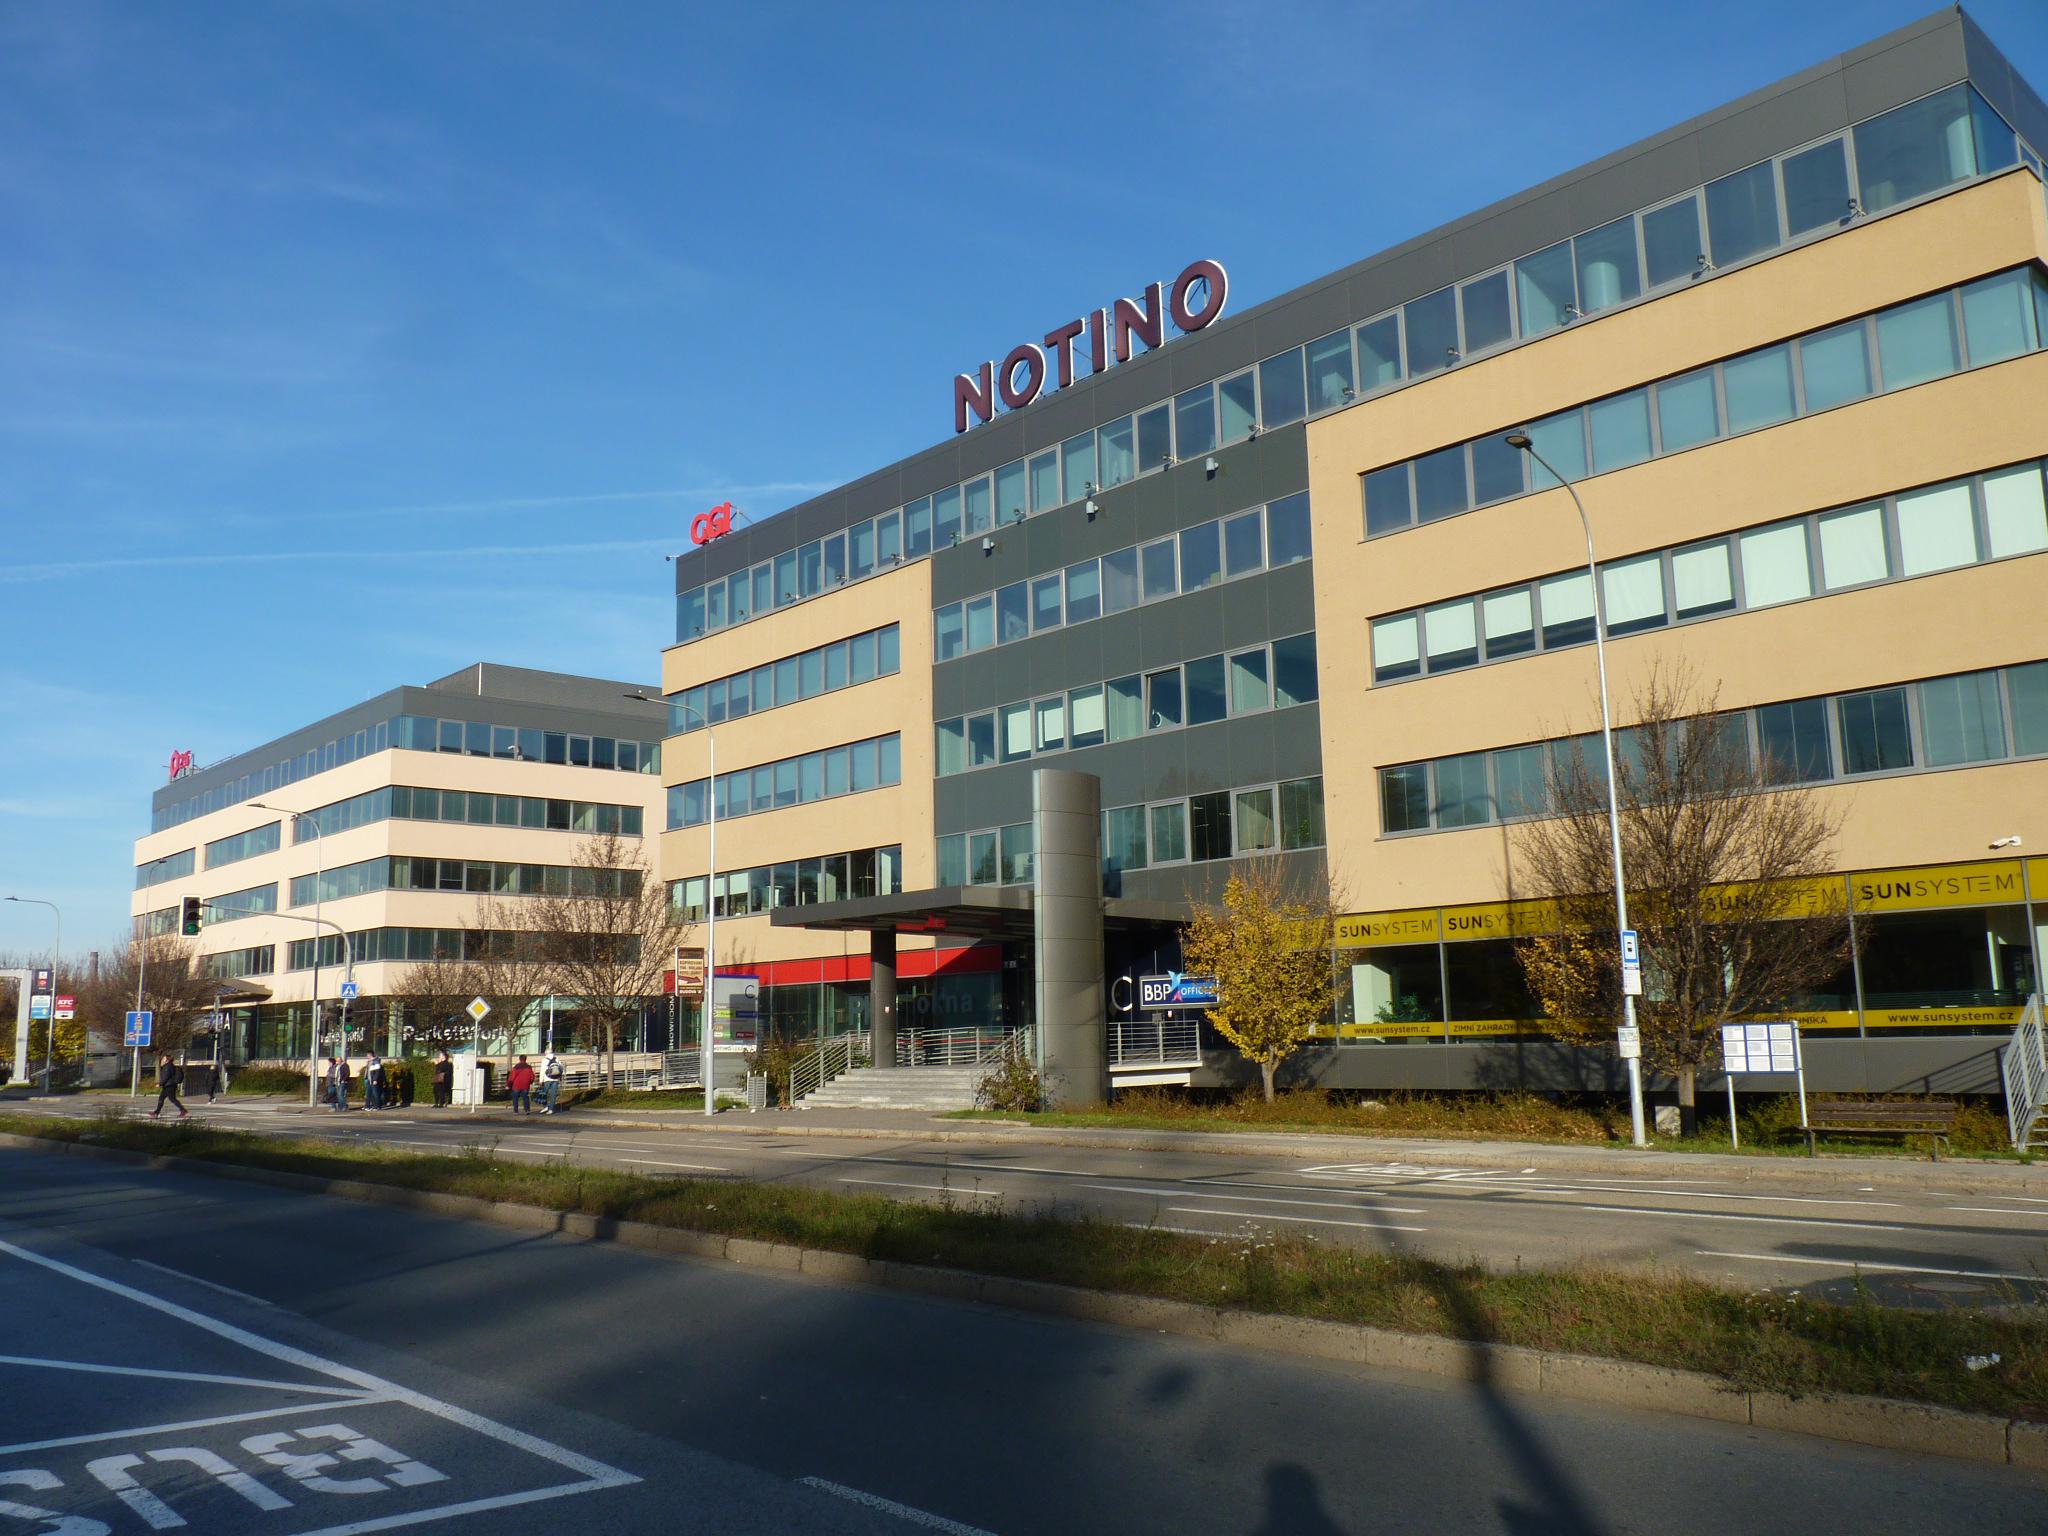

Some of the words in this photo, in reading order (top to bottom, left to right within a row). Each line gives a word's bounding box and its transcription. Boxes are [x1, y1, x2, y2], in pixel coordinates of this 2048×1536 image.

[954, 259, 1229, 433] NOTINO
[1862, 873, 2015, 900] SUNSYSTEM
[1704, 887, 1837, 912] SUNSTEM
[1340, 918, 1433, 938] SUNSYSTEM
[1448, 910, 1552, 930] SUNSYSTEM
[911, 988, 973, 1015] okna
[1111, 976, 1133, 1011] C
[1144, 983, 1171, 1002] BBP
[1888, 1011, 2015, 1023] www.sunsystem.cz
[1354, 1026, 1431, 1035] www.sunsystem.cz
[1476, 1023, 1514, 1032] ZAHRADY
